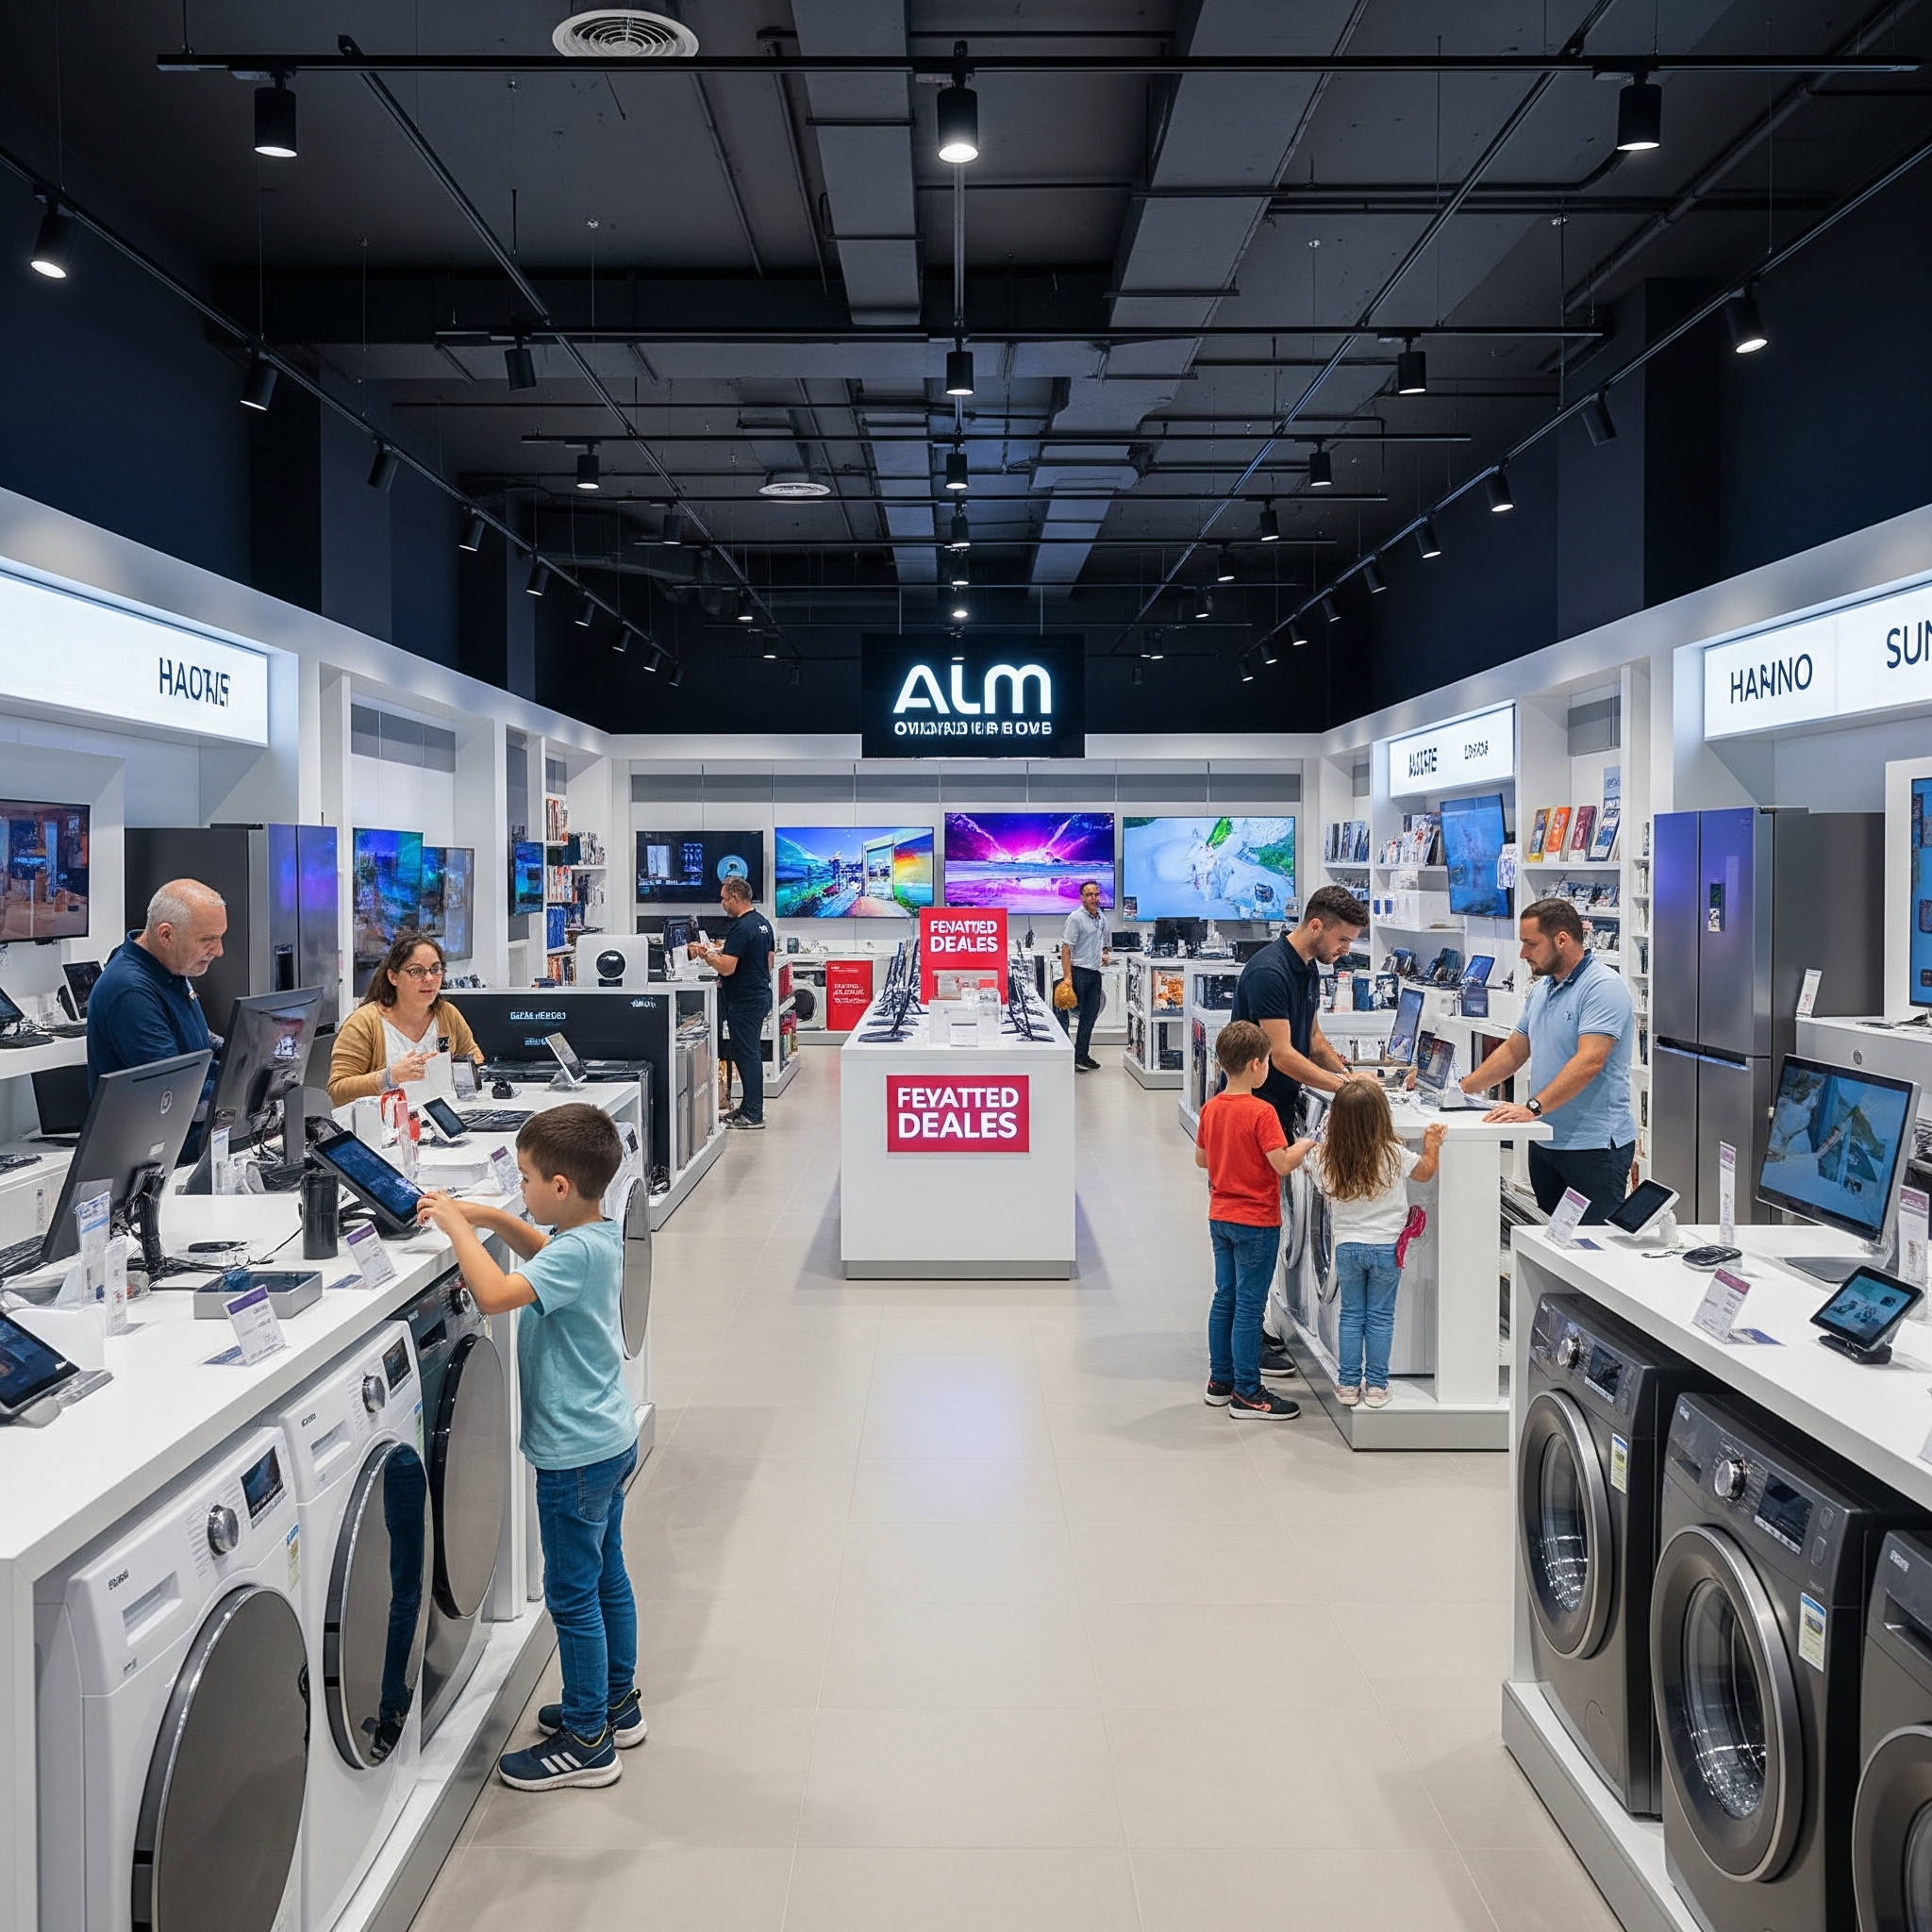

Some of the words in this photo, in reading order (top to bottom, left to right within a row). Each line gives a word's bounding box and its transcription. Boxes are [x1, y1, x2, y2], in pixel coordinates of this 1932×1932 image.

[930, 936, 999, 953] DEALES
[897, 1087, 1020, 1108] FEYATTED
[898, 1111, 1018, 1139] DEALES
